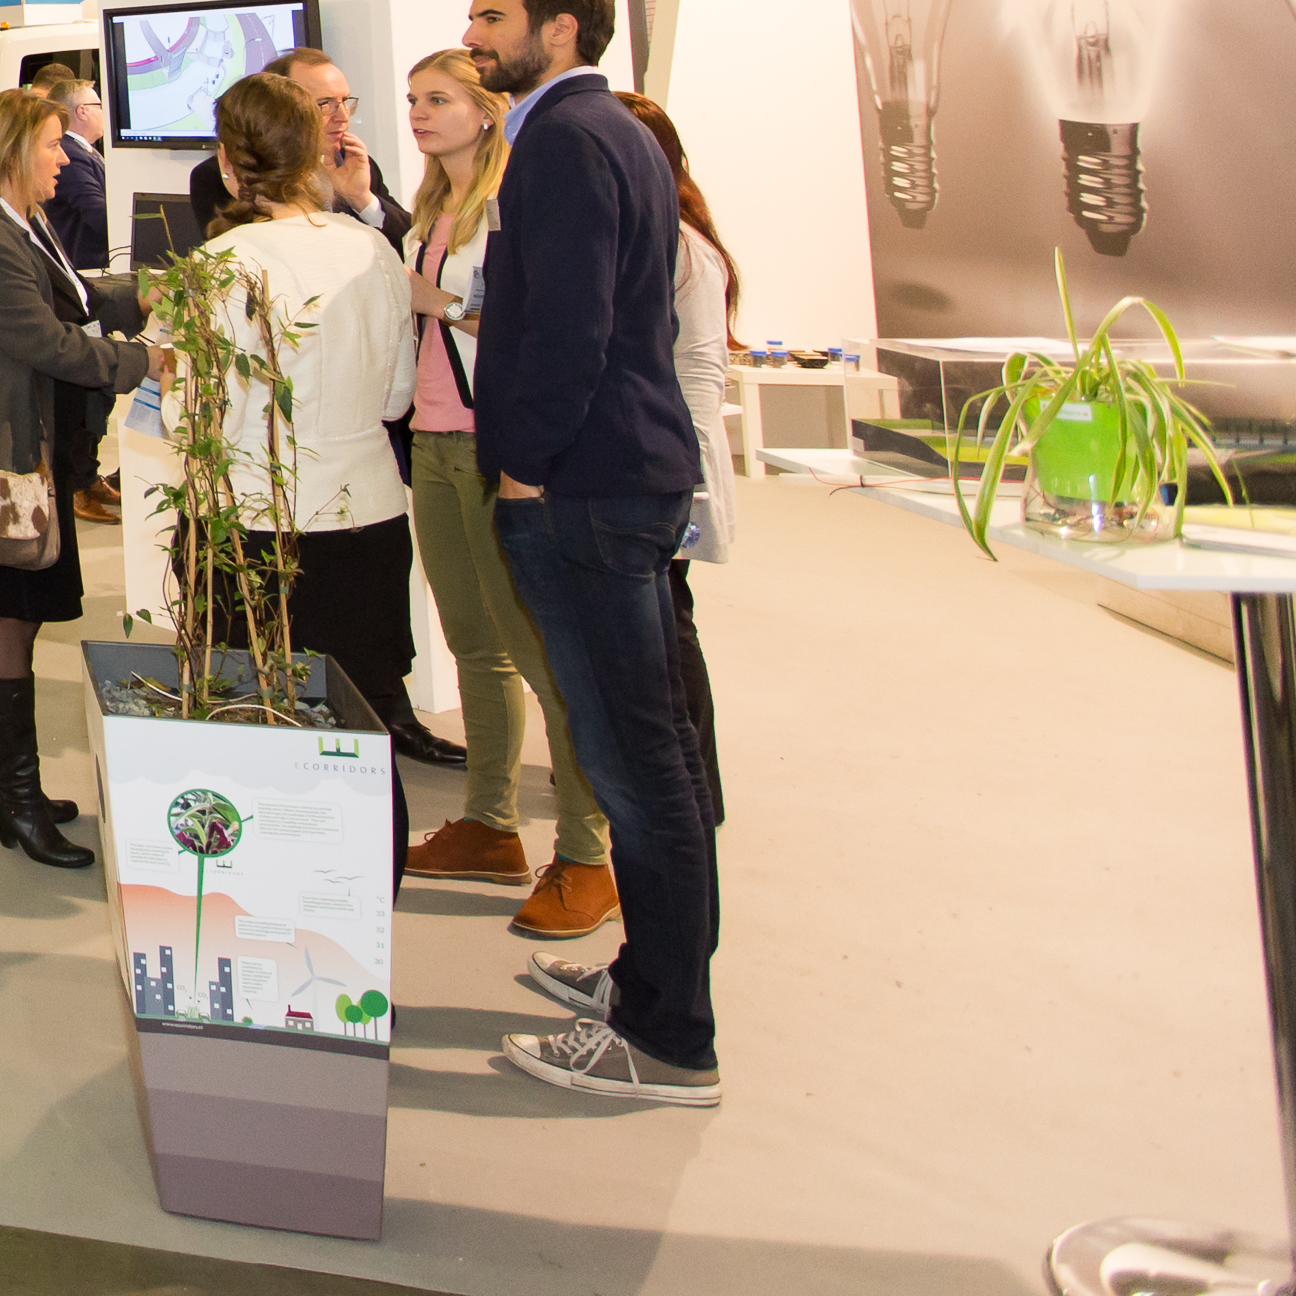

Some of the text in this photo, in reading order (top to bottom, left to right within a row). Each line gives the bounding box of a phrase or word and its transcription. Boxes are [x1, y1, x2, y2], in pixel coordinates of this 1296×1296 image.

[294, 762, 386, 775] ECORRIDORS
[375, 926, 385, 934] 32
[375, 941, 385, 949] 31
